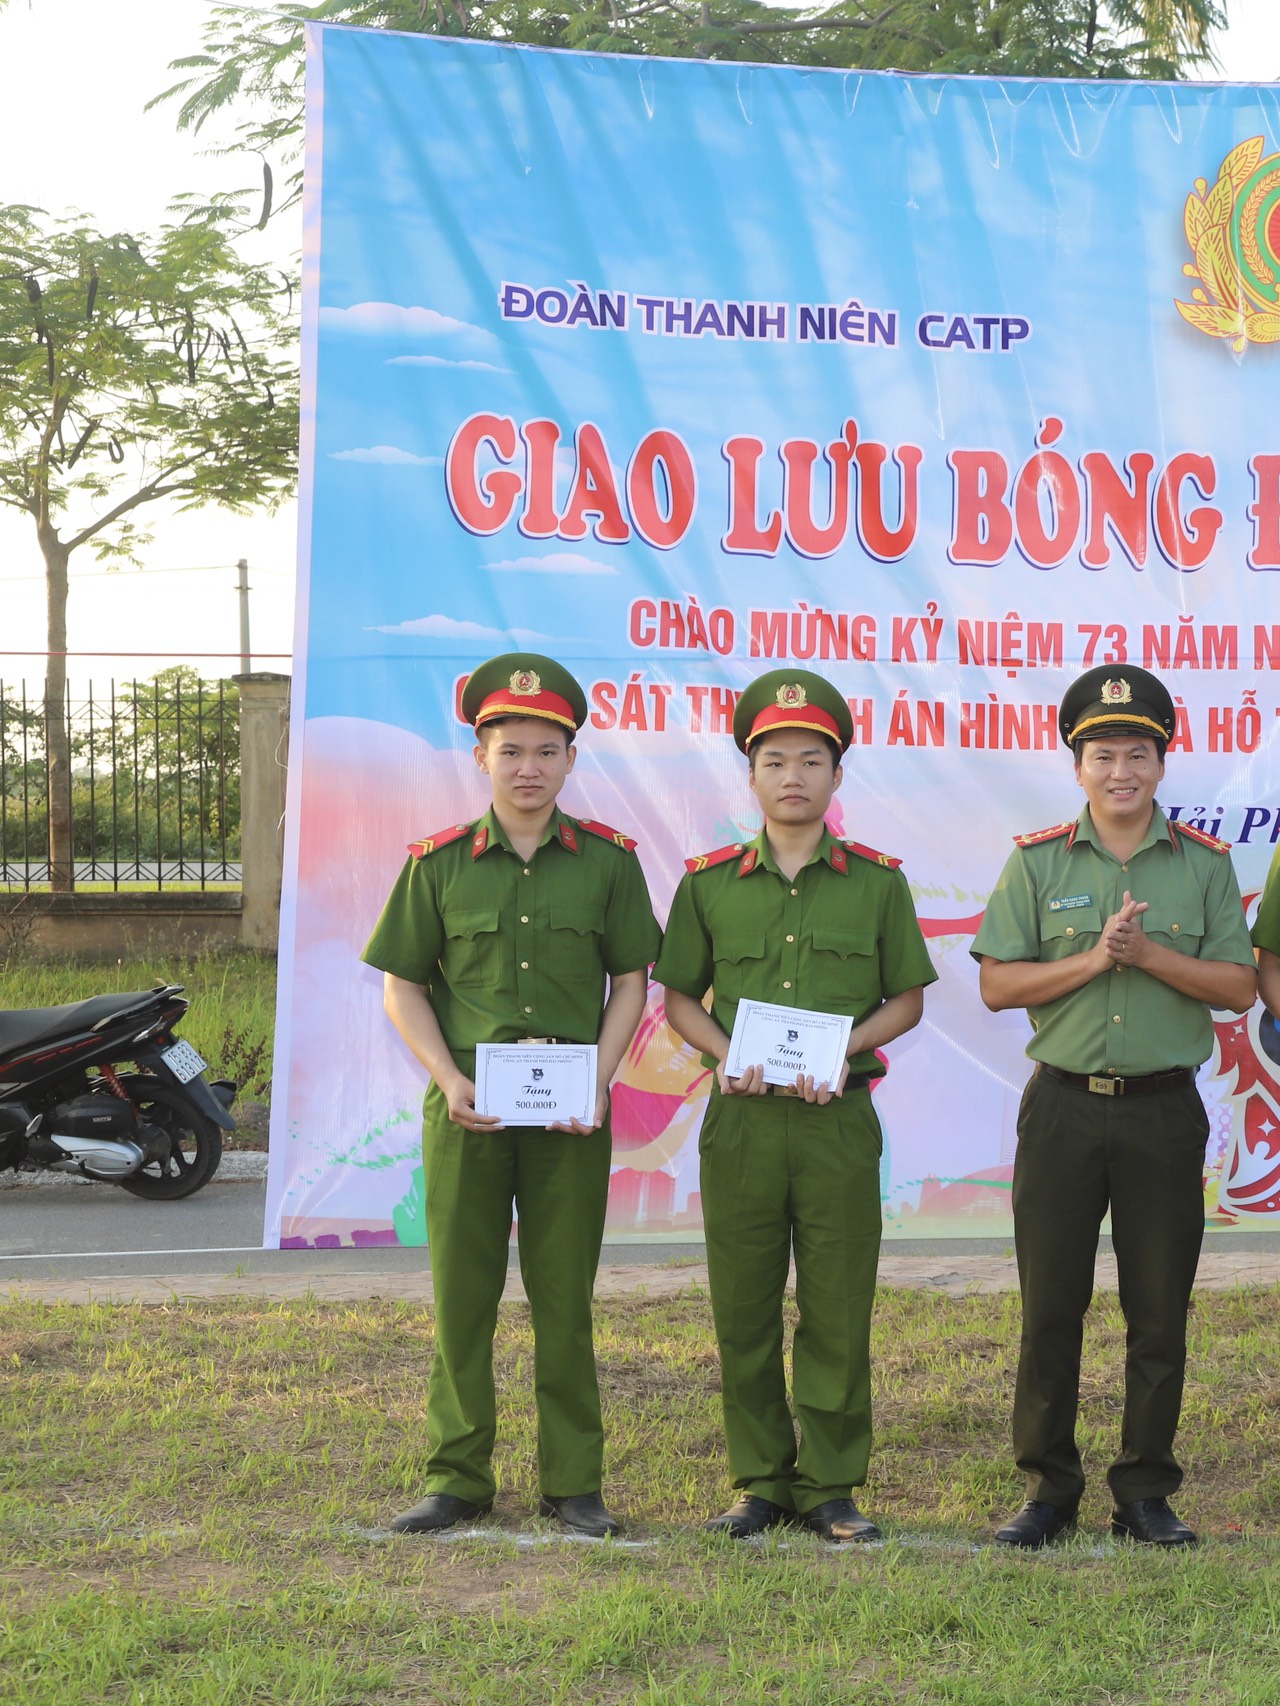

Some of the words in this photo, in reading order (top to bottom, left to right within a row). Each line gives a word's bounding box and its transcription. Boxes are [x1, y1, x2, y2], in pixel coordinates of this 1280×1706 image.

[501, 282, 625, 327] ĐOÀN
[637, 290, 784, 337] THANH
[800, 302, 896, 346] NIÊN
[916, 305, 1029, 350] CATP
[451, 416, 694, 545] GIAO
[728, 421, 922, 557] LƯU
[953, 418, 1222, 566] BÓNG
[632, 598, 734, 654] CHÀO
[751, 604, 875, 661] MỪNG
[893, 602, 943, 662] KỶ
[958, 612, 1062, 678] NIỆM
[1079, 625, 1127, 666] 73
[1144, 617, 1237, 669] NĂM
[591, 674, 670, 731] SÁT
[686, 686, 745, 734] TH
[888, 691, 944, 746] ÁN
[961, 693, 1057, 751] HÌNH
[1209, 691, 1260, 752] HỖ
[766, 1057, 807, 1071] 500.000Đ
[515, 1101, 557, 1109] 500.000Đ
